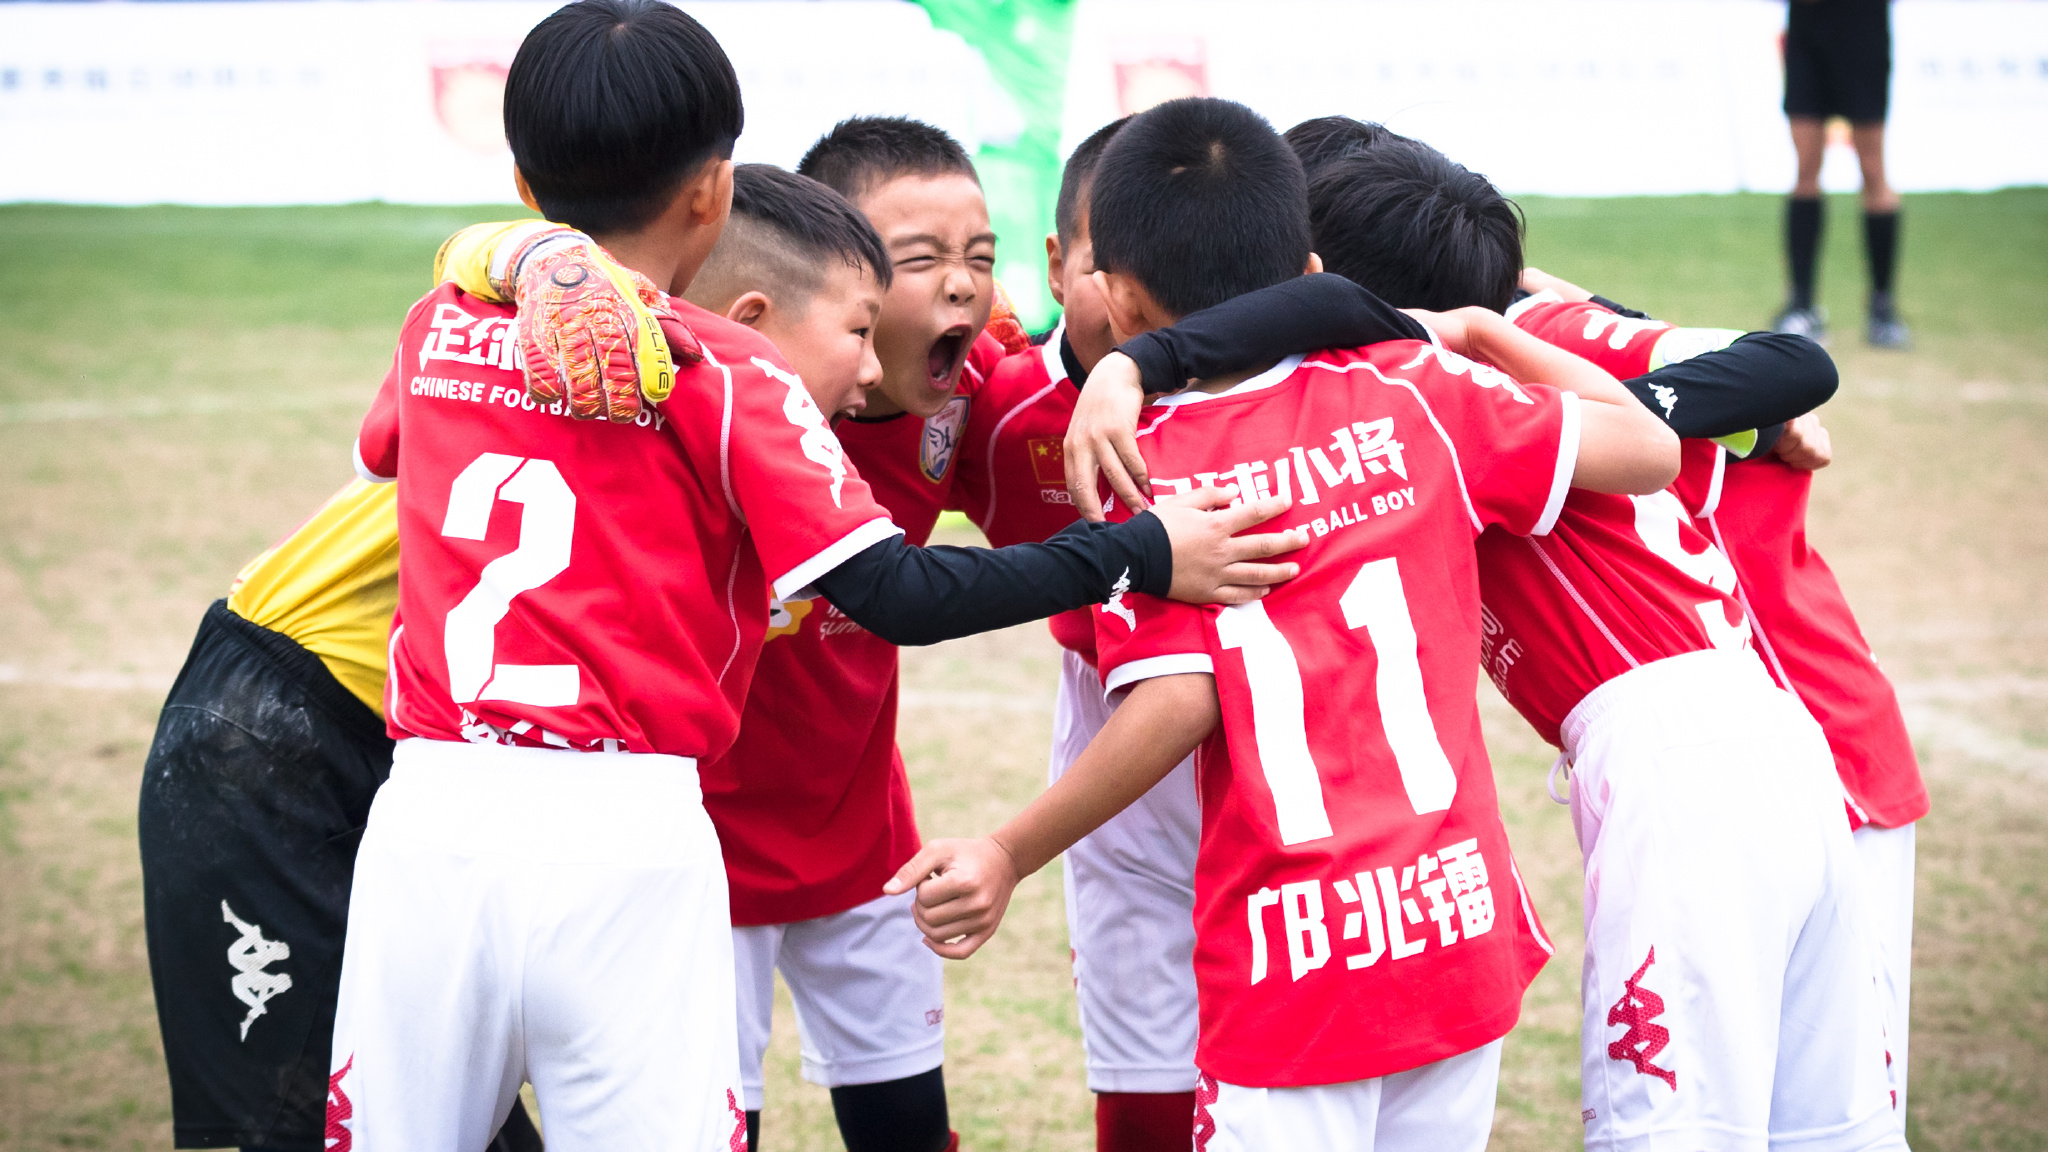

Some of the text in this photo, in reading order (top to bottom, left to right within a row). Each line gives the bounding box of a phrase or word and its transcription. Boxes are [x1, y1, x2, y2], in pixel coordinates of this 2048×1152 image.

[410, 376, 485, 403] CHINESE
[645, 316, 670, 390] ELITE
[1371, 486, 1416, 516] BOY
[441, 452, 580, 707] 2
[1215, 556, 1457, 846] 11
[1247, 837, 1496, 986] 邝兆镭
